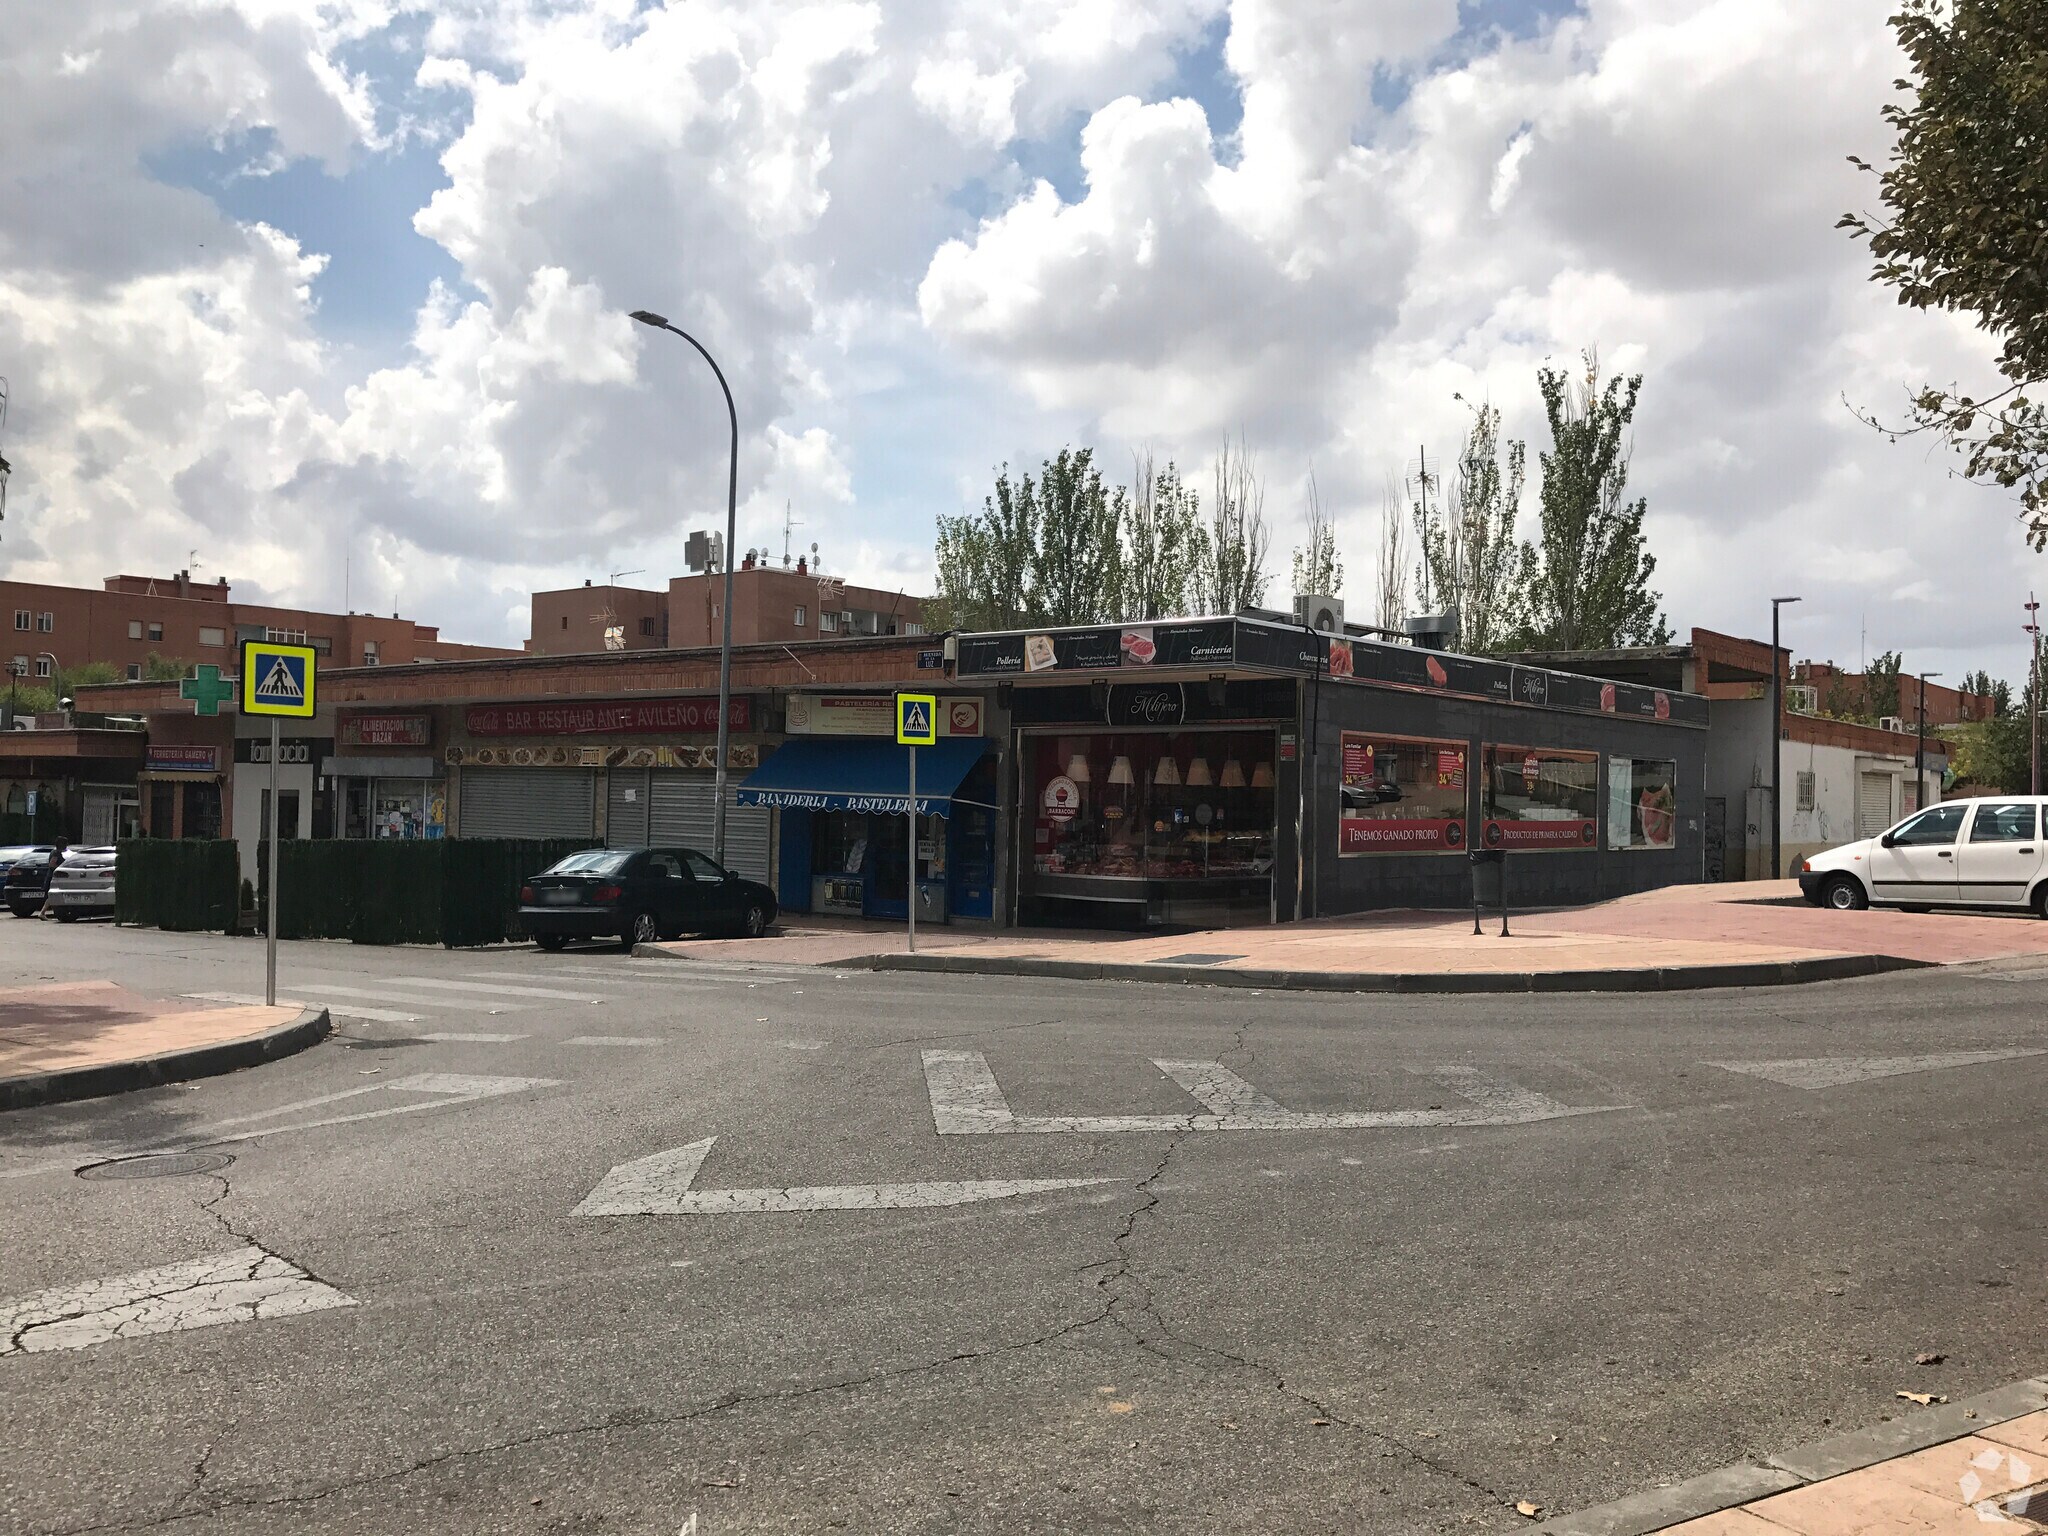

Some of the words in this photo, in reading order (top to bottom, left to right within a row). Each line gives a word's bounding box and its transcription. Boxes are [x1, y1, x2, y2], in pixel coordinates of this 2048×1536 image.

[1190, 645, 1232, 655] Carnicería
[925, 660, 935, 668] LUZ
[996, 656, 1021, 665] Pollería
[506, 711, 532, 729] BAR
[538, 707, 633, 729] RESTAURANTE
[638, 704, 698, 726] AVILEÑO
[362, 719, 404, 732] ALIMENTACION
[372, 732, 393, 743] BAZAR
[153, 749, 183, 759] FERRETERIA
[184, 750, 206, 760] GAMERO
[28, 794, 34, 813] P
[756, 792, 829, 809] PANADERIA
[1383, 829, 1414, 841] GANADO
[1415, 829, 1439, 840] PROPIO
[1532, 830, 1539, 839] DE
[1539, 830, 1558, 839] PRIMERA
[1559, 830, 1578, 839] CALIDAD
